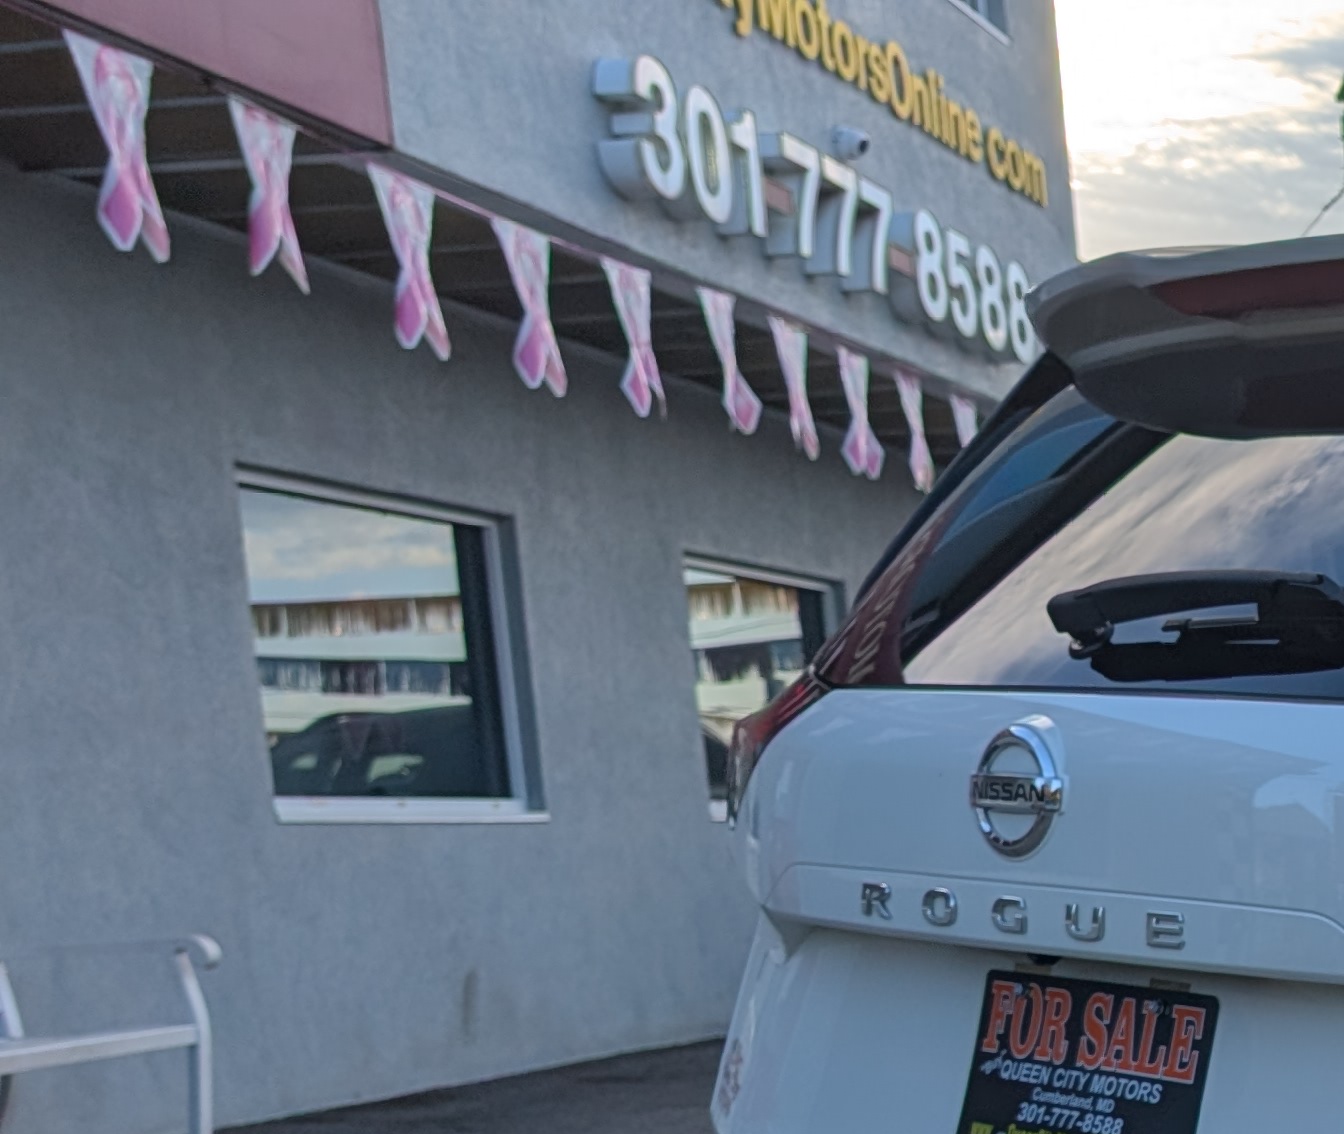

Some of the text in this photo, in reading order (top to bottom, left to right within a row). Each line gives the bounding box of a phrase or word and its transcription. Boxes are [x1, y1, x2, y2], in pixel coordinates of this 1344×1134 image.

[720, 0, 983, 164] yMotorsOnline
[972, 780, 1046, 803] NISSAN
[860, 881, 1187, 951] ROGUE
[982, 979, 1207, 1085] FOR SALE
[1000, 1058, 1053, 1086] QUEEN
[1052, 1067, 1091, 1092] CITY
[1089, 1073, 1163, 1105] MOTORS
[1095, 1097, 1116, 1114] MD
